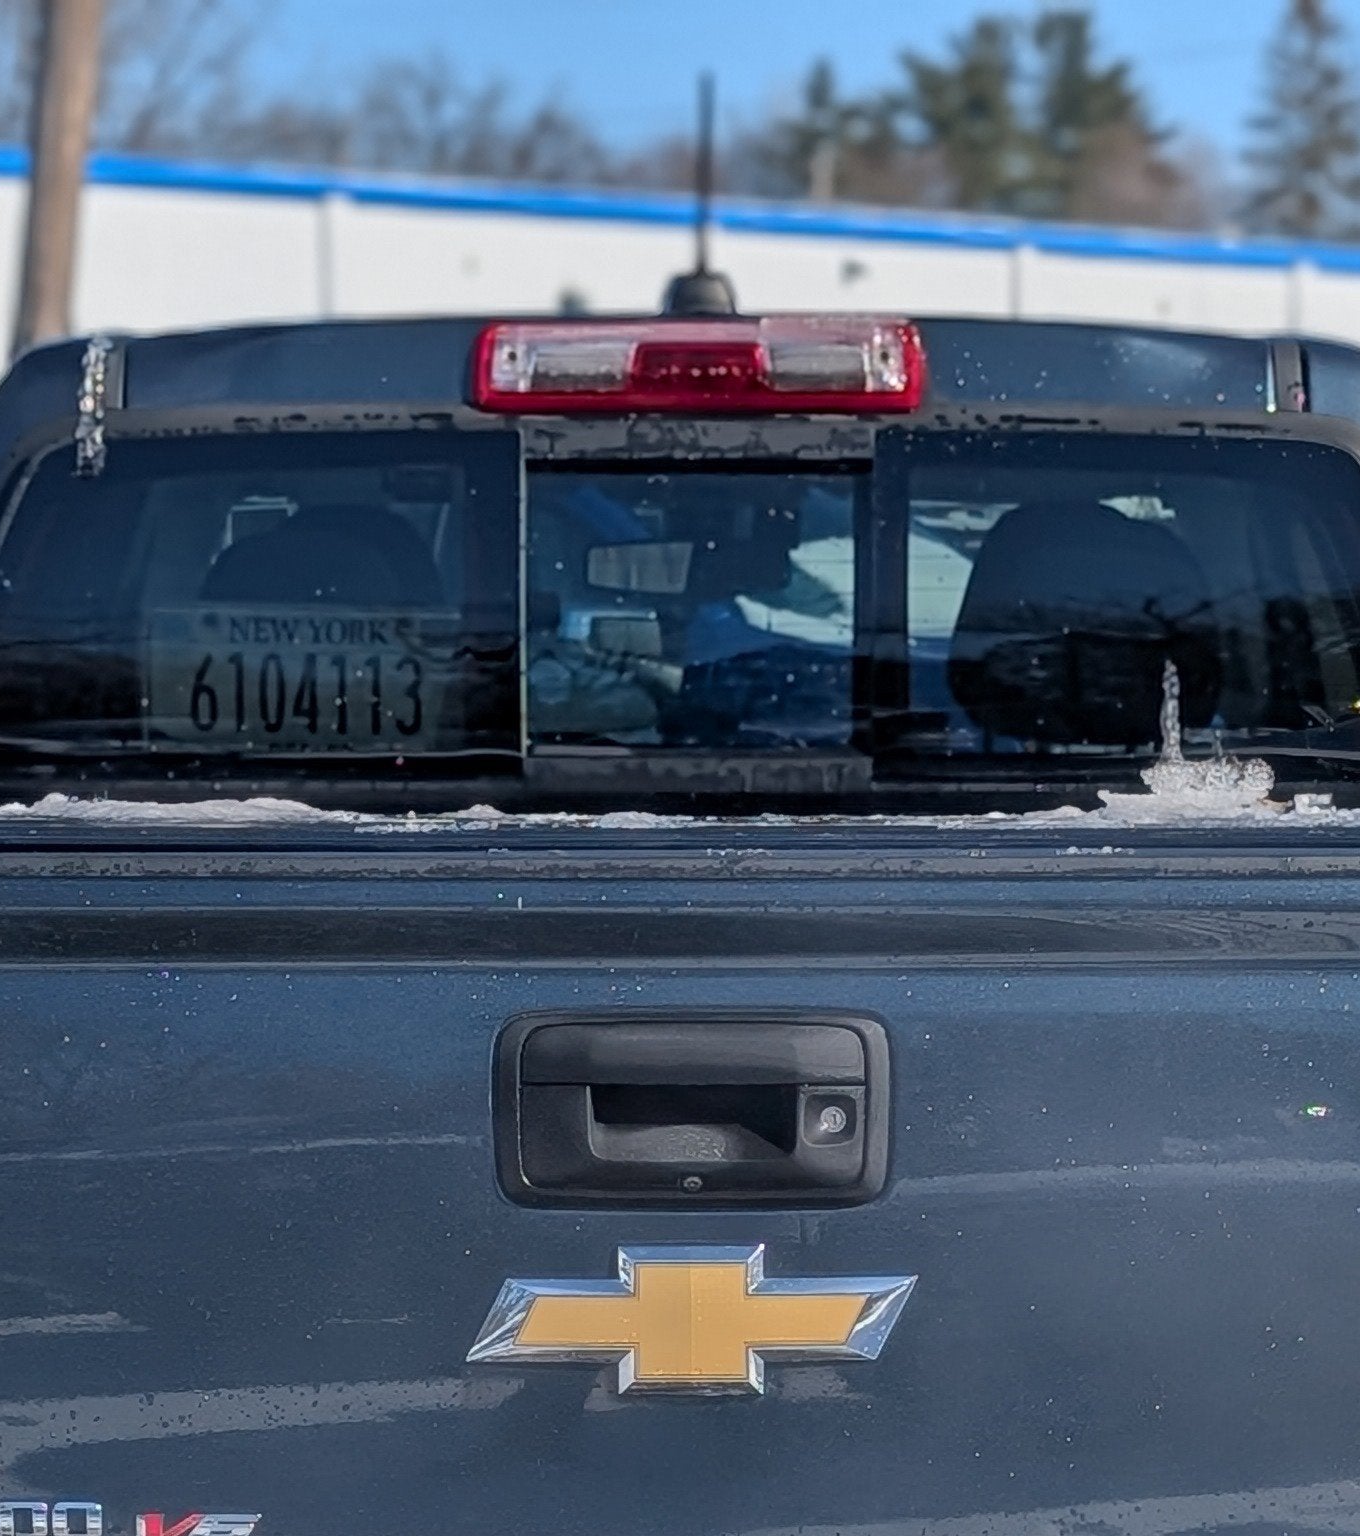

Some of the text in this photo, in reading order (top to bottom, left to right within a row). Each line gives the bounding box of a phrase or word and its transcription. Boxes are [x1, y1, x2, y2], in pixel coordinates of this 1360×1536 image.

[229, 616, 389, 645] NEW YORK
[190, 651, 423, 736] 6104113
